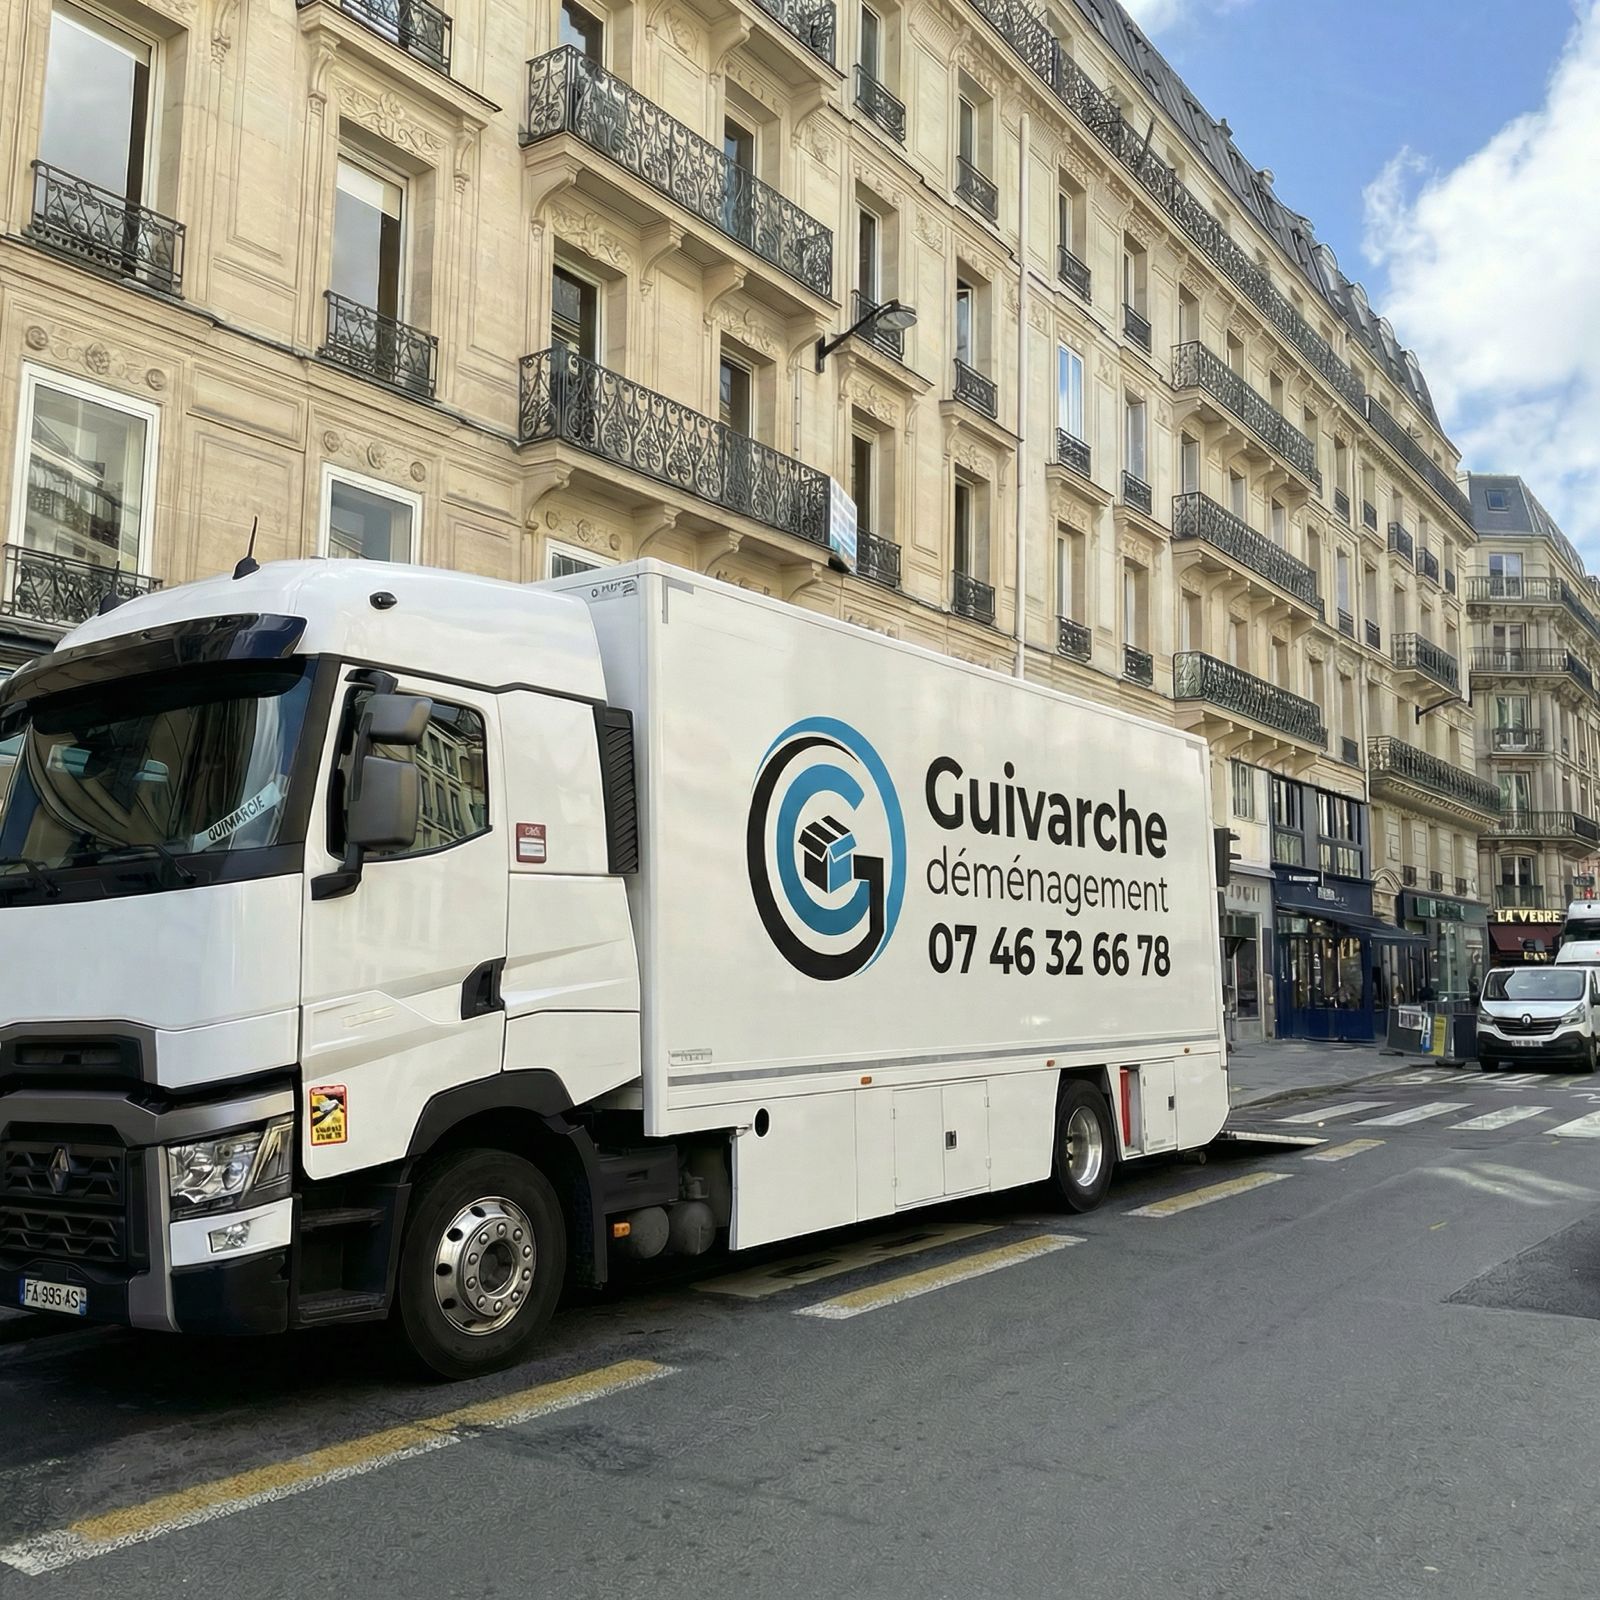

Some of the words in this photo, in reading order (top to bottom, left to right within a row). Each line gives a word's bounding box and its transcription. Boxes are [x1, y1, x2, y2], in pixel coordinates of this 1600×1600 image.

[925, 756, 1168, 859] Guivarche
[926, 845, 1169, 916] déménagement
[928, 923, 977, 974] 07
[990, 927, 1036, 976] 46
[1045, 929, 1083, 976] 32
[1093, 931, 1130, 976] 66
[1137, 934, 1171, 977] 78
